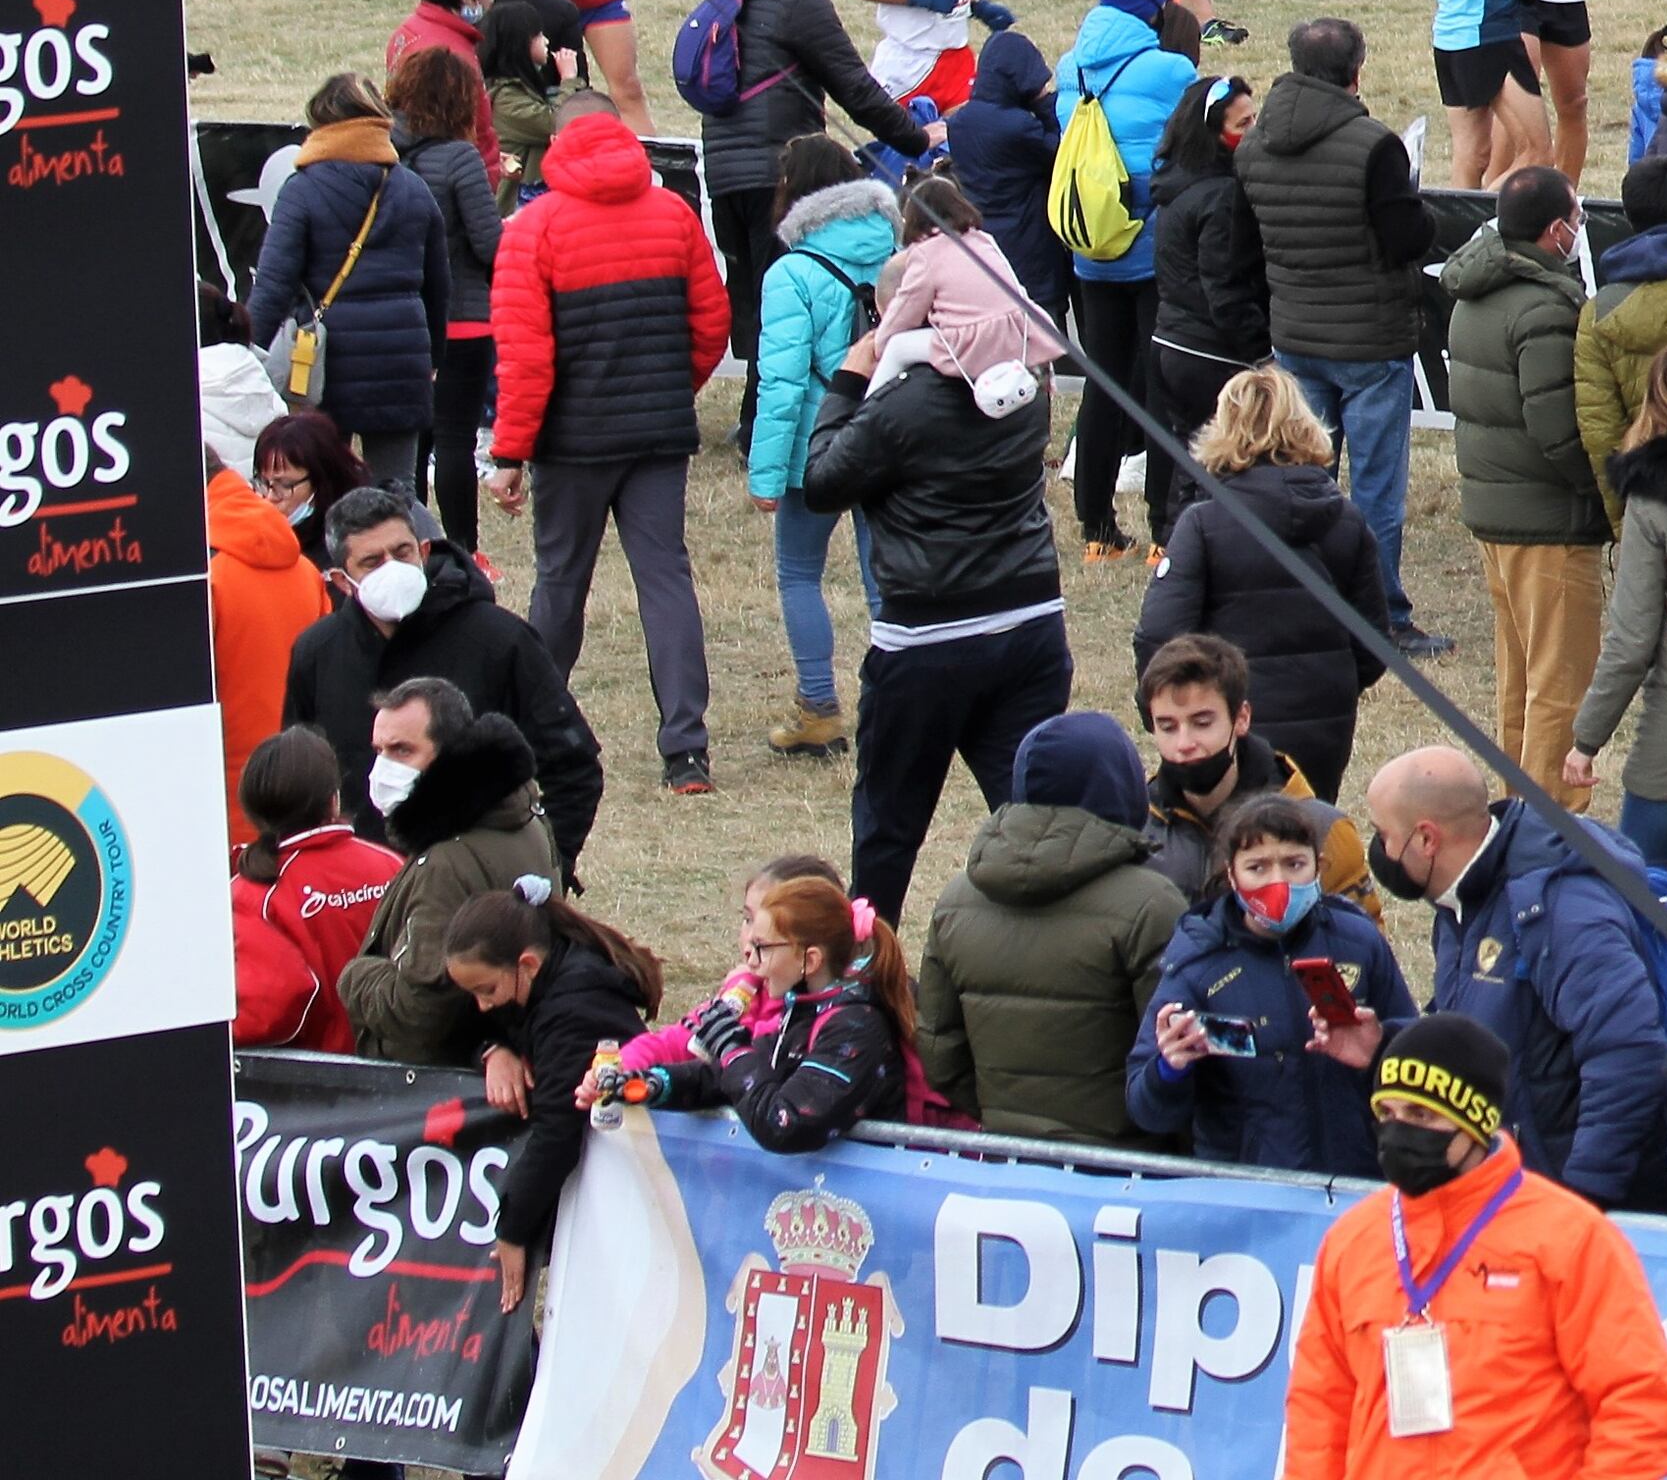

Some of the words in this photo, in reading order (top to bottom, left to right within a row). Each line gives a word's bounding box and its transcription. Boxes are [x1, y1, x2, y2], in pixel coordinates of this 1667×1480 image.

[8, 130, 124, 189] alimenta
[28, 516, 143, 577] alimenta
[99, 818, 124, 874] TOUR
[0, 933, 74, 961] HLETICS
[91, 877, 125, 969] COUNTRY
[42, 966, 95, 1013] CROSS
[61, 1286, 178, 1348] alimenta
[368, 1280, 483, 1364] alimenta
